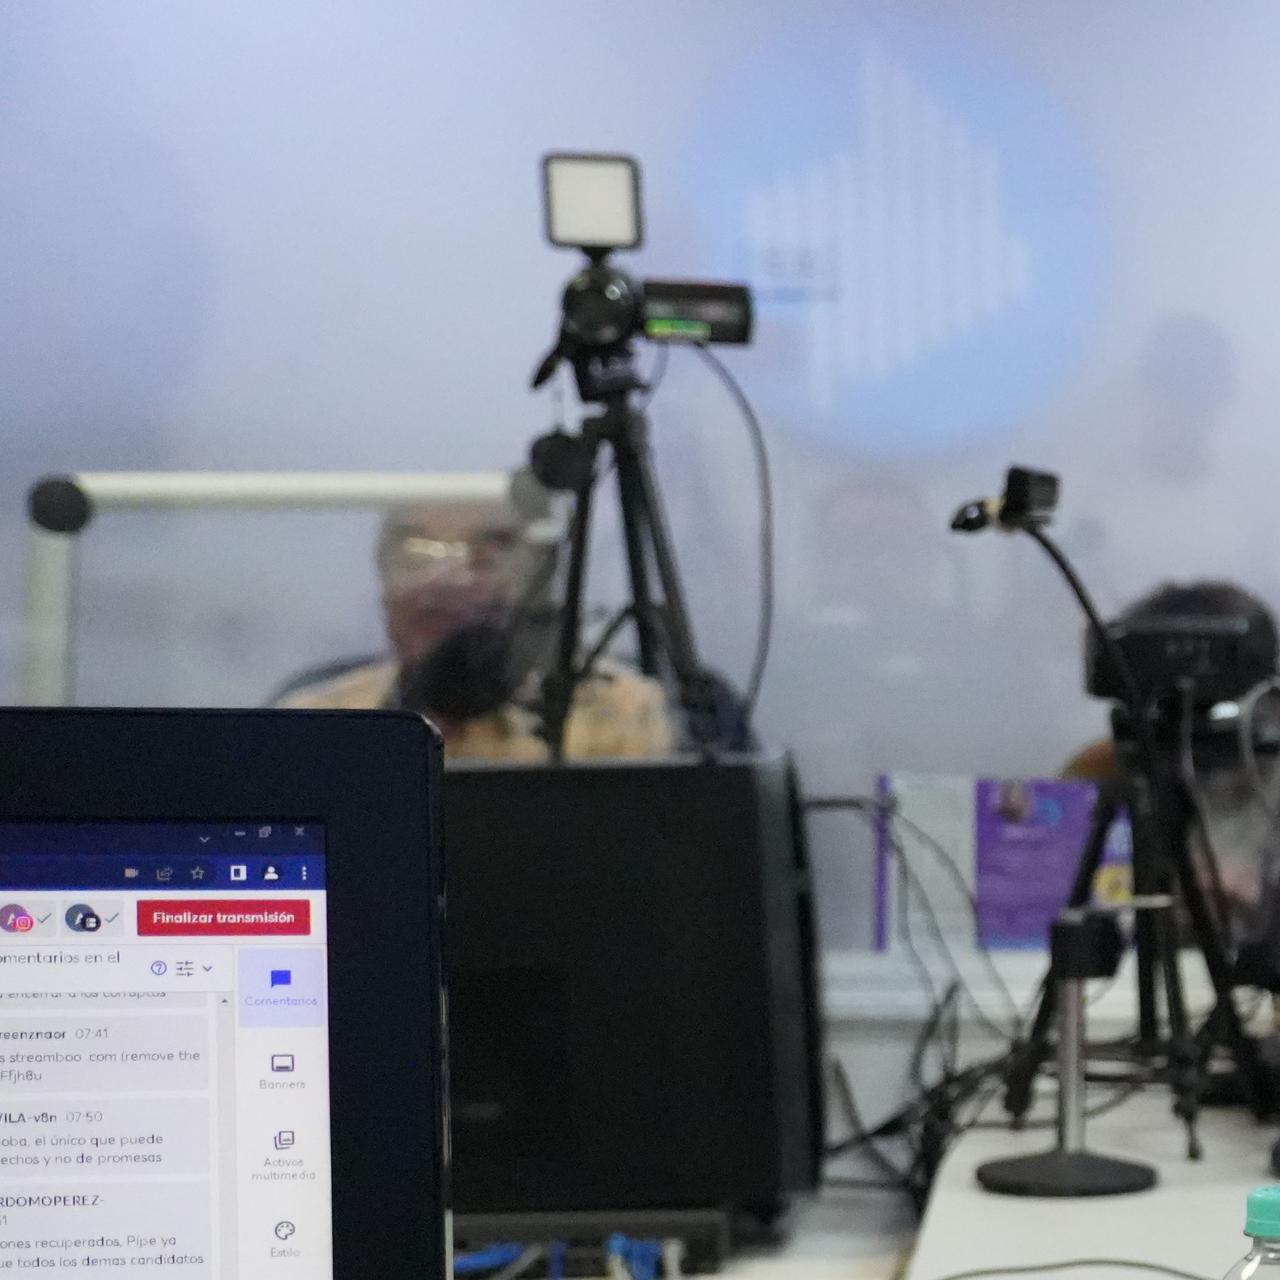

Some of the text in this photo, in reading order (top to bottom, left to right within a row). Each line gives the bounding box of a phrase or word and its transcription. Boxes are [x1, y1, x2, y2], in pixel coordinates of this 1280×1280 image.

[153, 911, 295, 924] Finalizar transmisión
[84, 954, 103, 964] en
[107, 951, 121, 963] el
[179, 1050, 201, 1061] the
[259, 1080, 306, 1090] Banners
[35, 1136, 46, 1146] el
[90, 1136, 116, 1148] que
[120, 1134, 164, 1147] puede
[55, 1156, 72, 1165] no
[76, 1153, 93, 1165] de
[97, 1153, 163, 1167] promesas
[264, 1158, 304, 1168] Activos
[251, 1171, 316, 1181] multimedia
[17, 1256, 56, 1268] todos
[59, 1256, 78, 1267] los
[130, 1253, 205, 1266] candidatos
